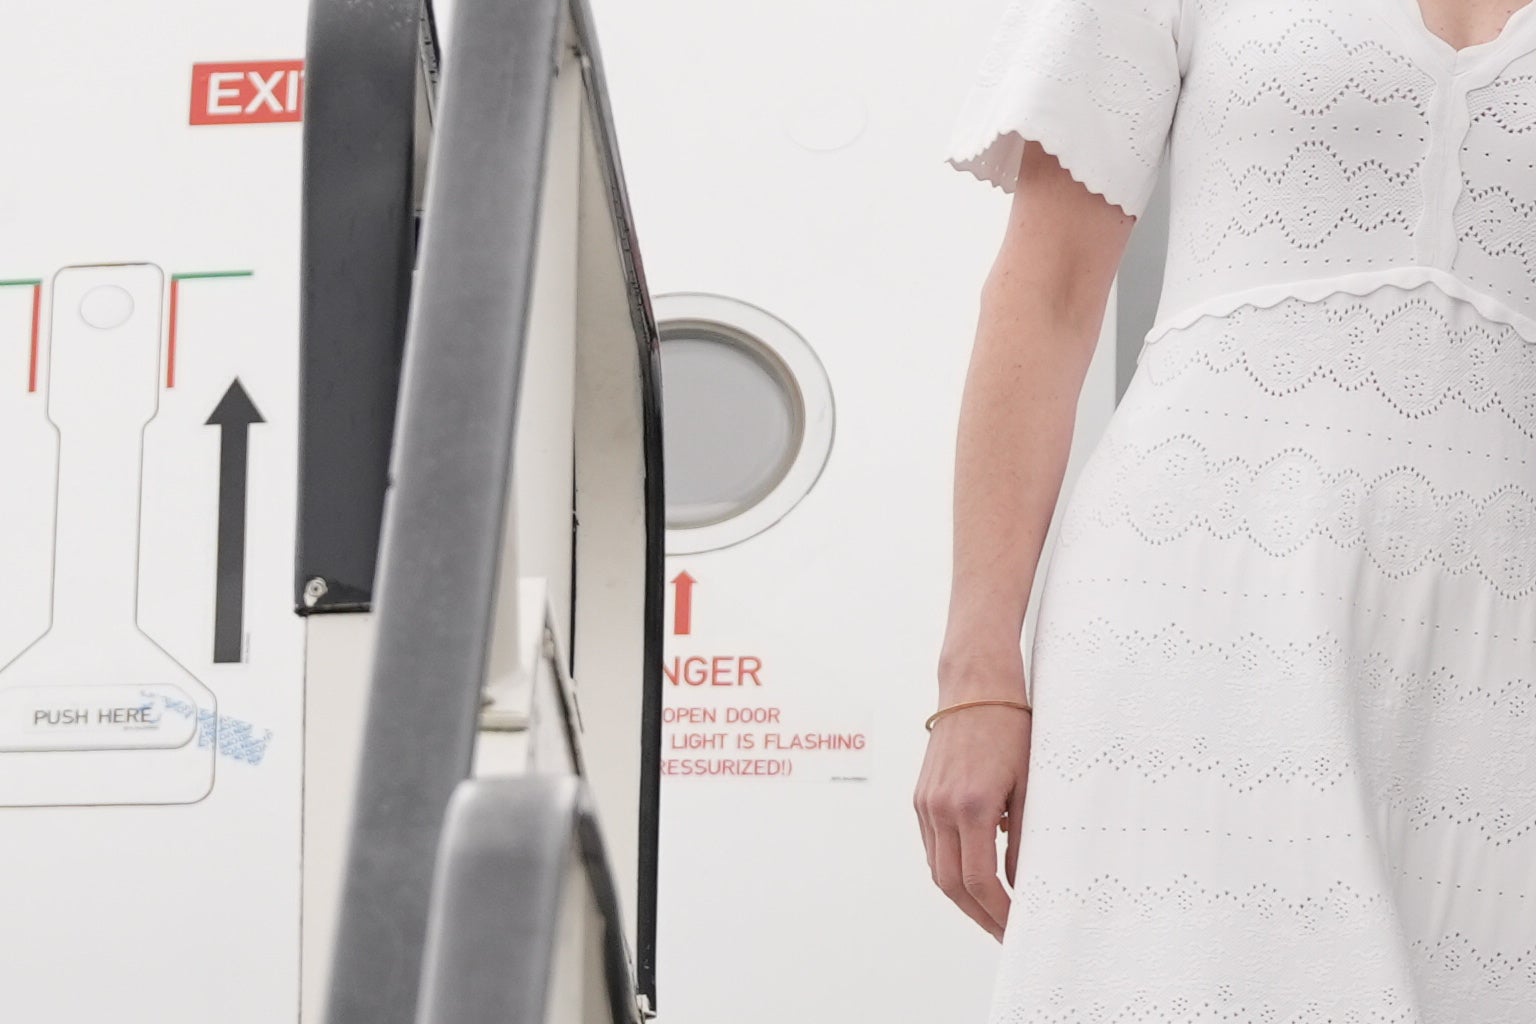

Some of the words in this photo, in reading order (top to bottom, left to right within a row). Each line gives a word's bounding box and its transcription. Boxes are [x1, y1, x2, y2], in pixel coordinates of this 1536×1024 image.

[206, 70, 305, 115] EXI
[662, 655, 763, 687] NGER
[34, 709, 89, 725] PUSH
[98, 707, 153, 724] HERE
[662, 707, 717, 724] OPEN
[726, 707, 781, 724] DOOR
[671, 733, 728, 749] LIGHT
[737, 733, 755, 749] IS
[764, 733, 866, 750] FLASHING
[660, 759, 793, 776] RESSURIZED!)
